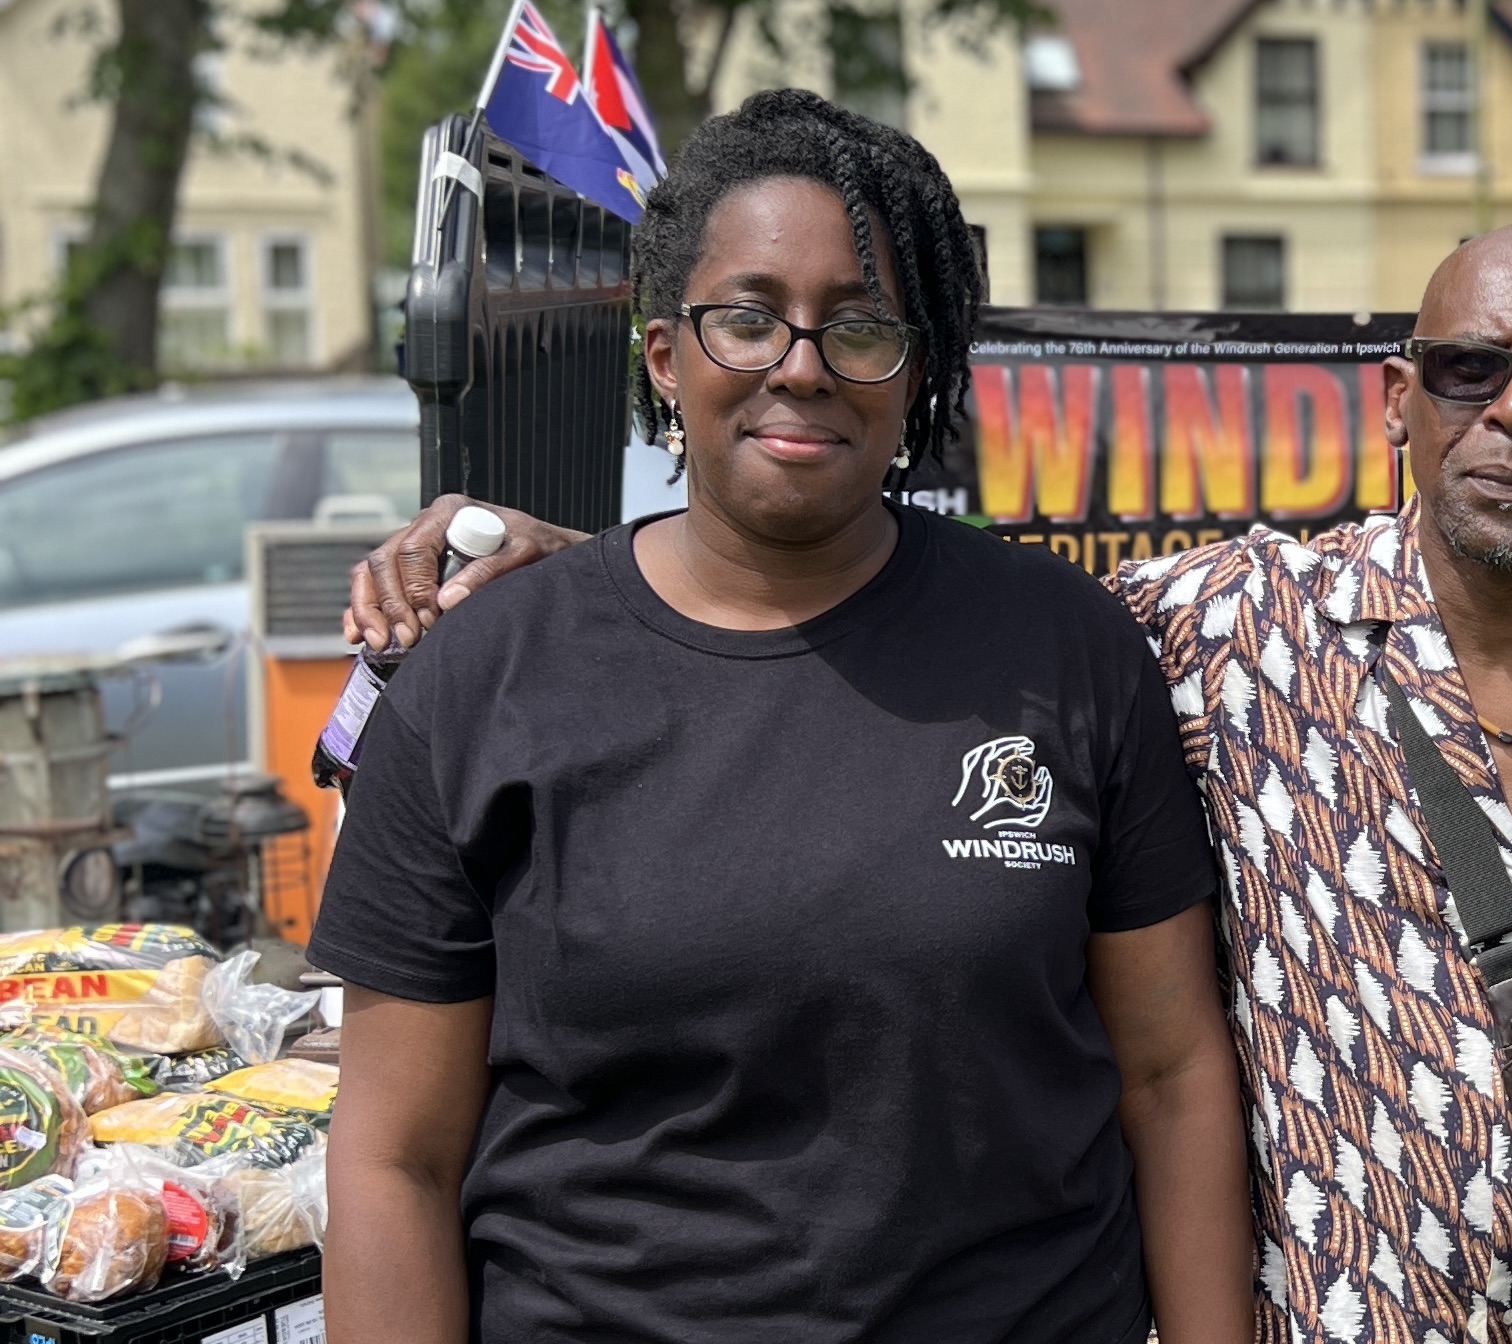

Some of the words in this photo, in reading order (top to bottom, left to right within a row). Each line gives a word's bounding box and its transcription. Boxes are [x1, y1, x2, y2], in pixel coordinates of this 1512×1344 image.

[968, 341, 1042, 356] Celebrating
[1045, 342, 1066, 355] the
[1069, 342, 1096, 355] 76th
[1099, 342, 1172, 357] Anniversary
[1175, 342, 1187, 355] of
[1190, 342, 1211, 355] the
[1214, 342, 1270, 355] Windrush
[1274, 342, 1338, 355] Generation
[1342, 342, 1353, 355] in
[1357, 341, 1401, 356] Ipswich
[998, 831, 1036, 839] IPSWICH
[942, 840, 1076, 865] WINDRUSH
[1004, 860, 1042, 869] SOCIETY
